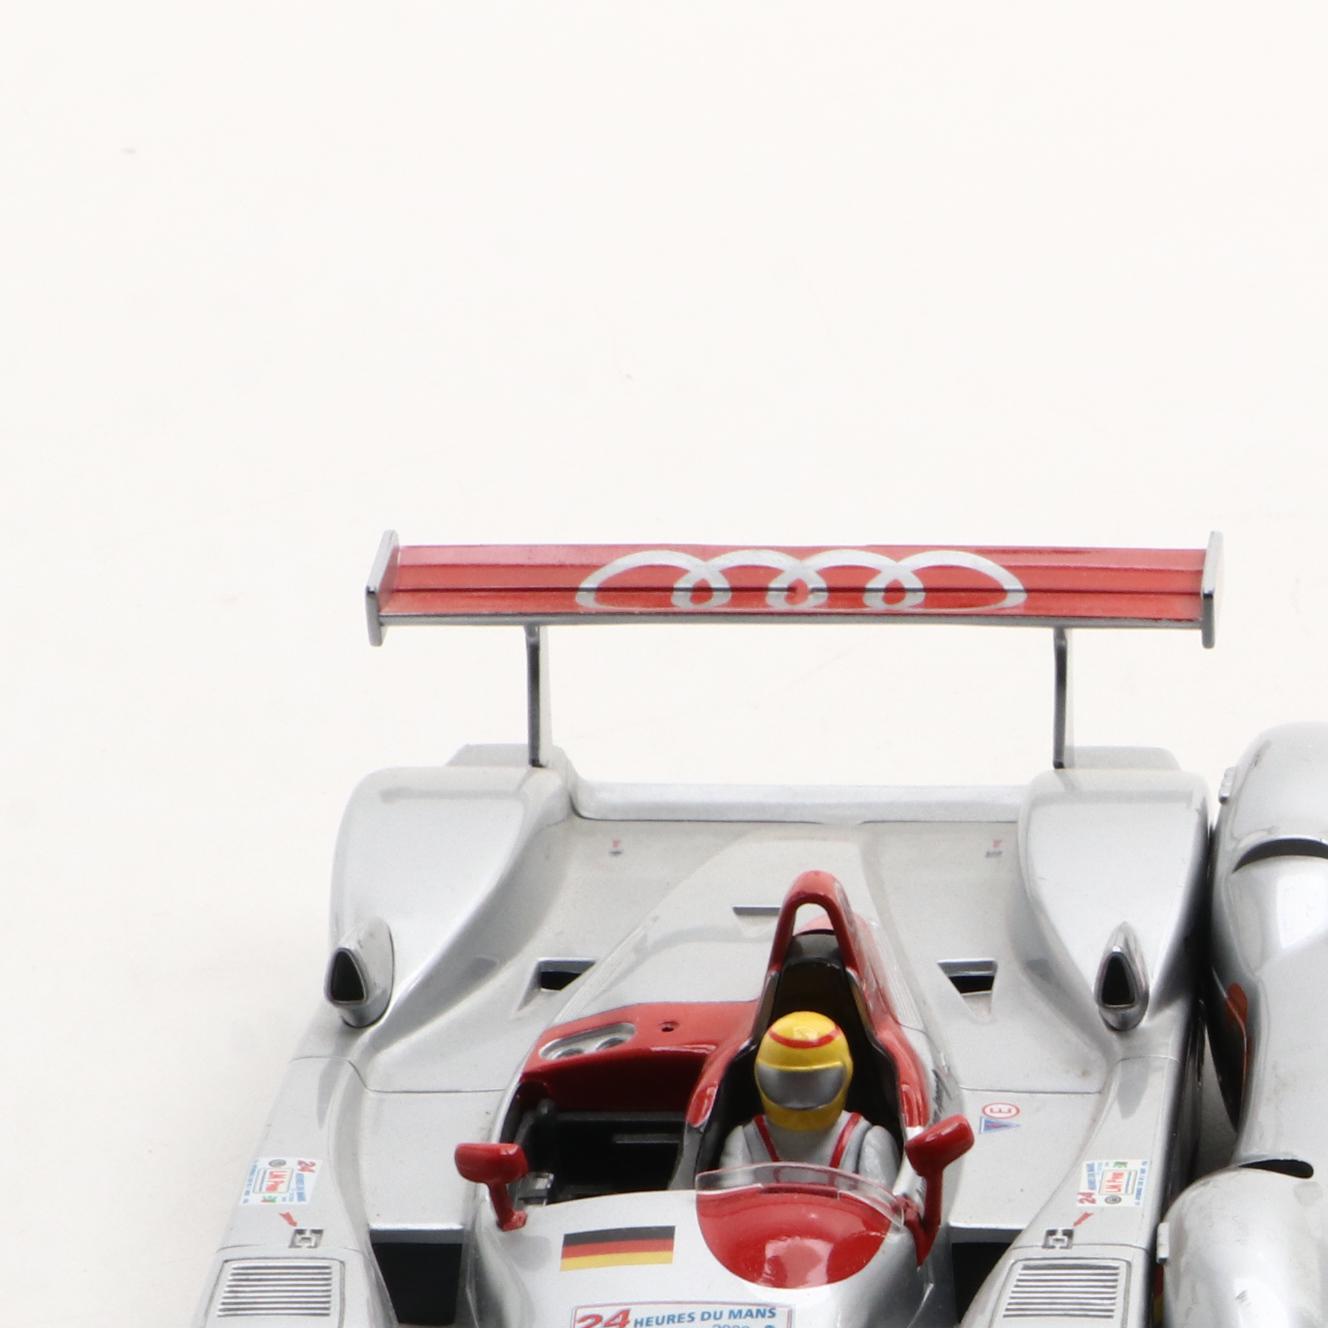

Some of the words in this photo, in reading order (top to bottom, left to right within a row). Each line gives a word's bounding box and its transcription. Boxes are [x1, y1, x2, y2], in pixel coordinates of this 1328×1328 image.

[633, 1312, 695, 1328] HEURES
[700, 1308, 724, 1322] DU
[728, 1306, 777, 1321] MANS
